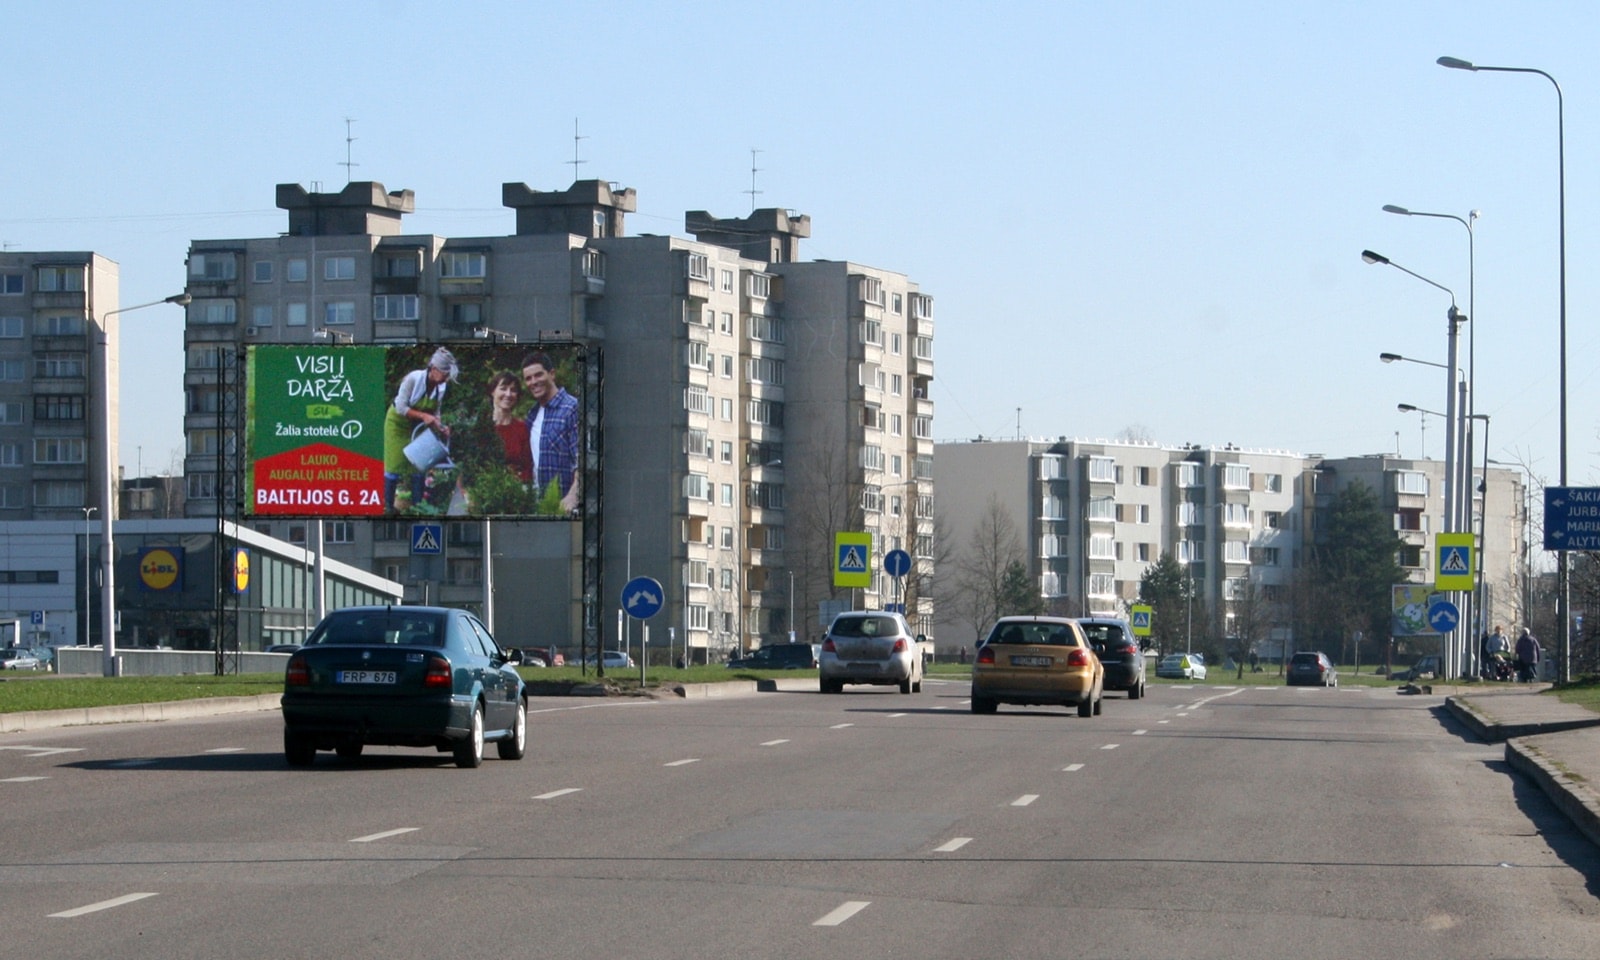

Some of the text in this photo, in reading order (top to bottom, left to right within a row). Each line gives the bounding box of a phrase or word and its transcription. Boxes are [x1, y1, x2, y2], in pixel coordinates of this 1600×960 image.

[296, 355, 334, 374] VISI
[286, 374, 355, 402] DARŽĄ
[275, 422, 339, 436] Žalia stotelė
[301, 454, 338, 466] LAUKO
[269, 467, 369, 482] AUGALŲ AIKŠTELĖ
[257, 489, 381, 505] BALTIJOS G. 2A
[1567, 506, 1600, 517] JURB
[343, 672, 394, 683] FRP 676
